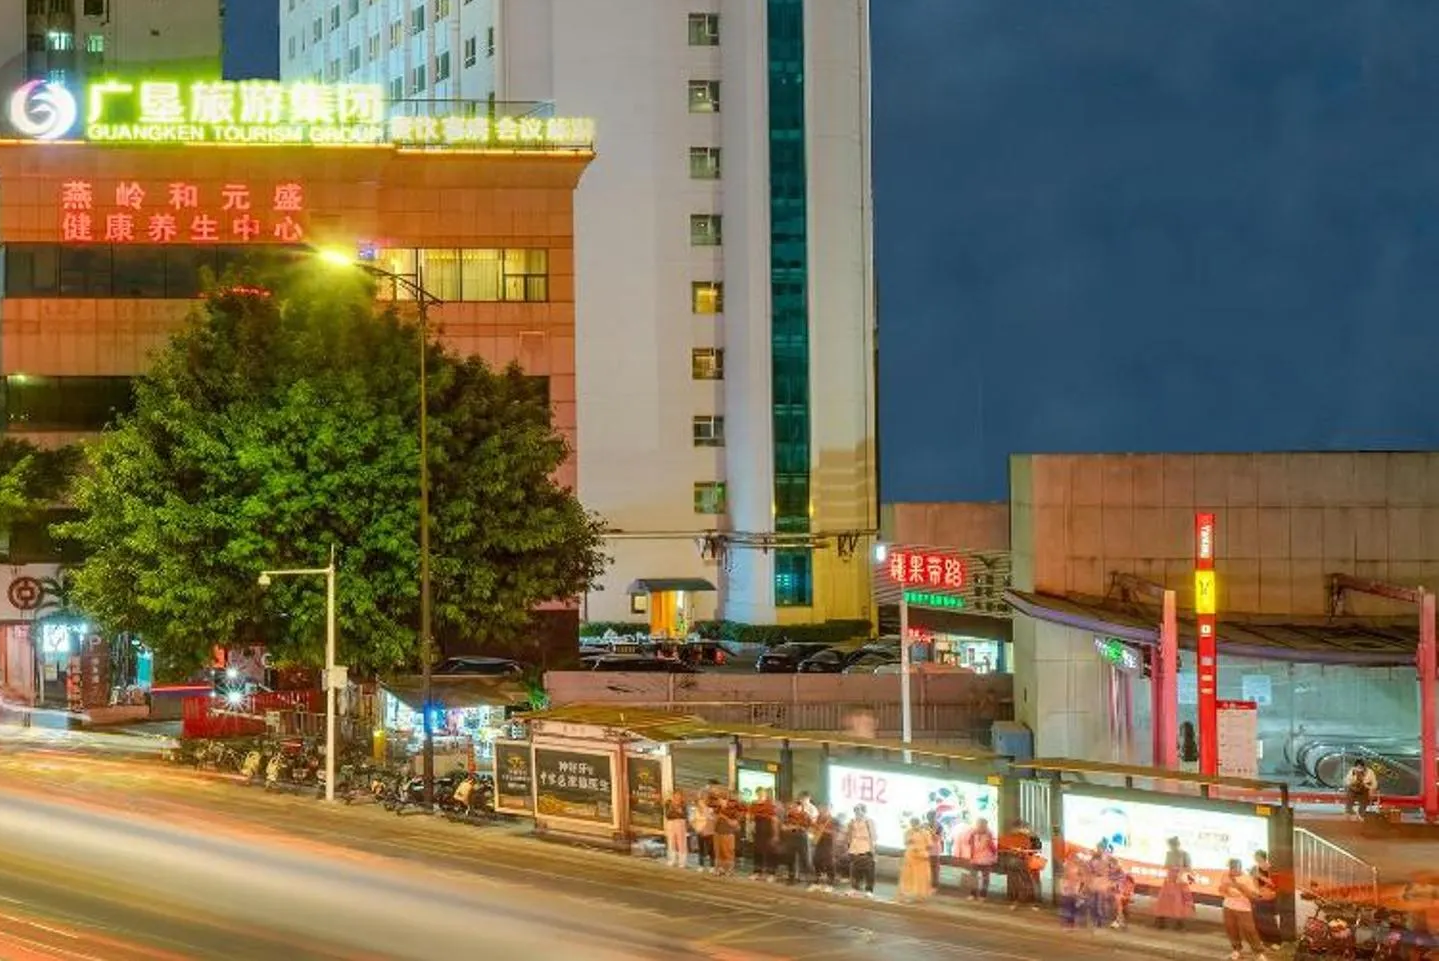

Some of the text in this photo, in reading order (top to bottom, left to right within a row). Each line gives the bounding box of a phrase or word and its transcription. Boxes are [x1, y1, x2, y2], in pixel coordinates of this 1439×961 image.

[88, 79, 384, 123] 广垦旅游集团
[87, 124, 384, 143] GUANGKEN TOURISM GROUP
[62, 181, 304, 211] 燕岭和元盛
[62, 213, 304, 242] 健康养生中心
